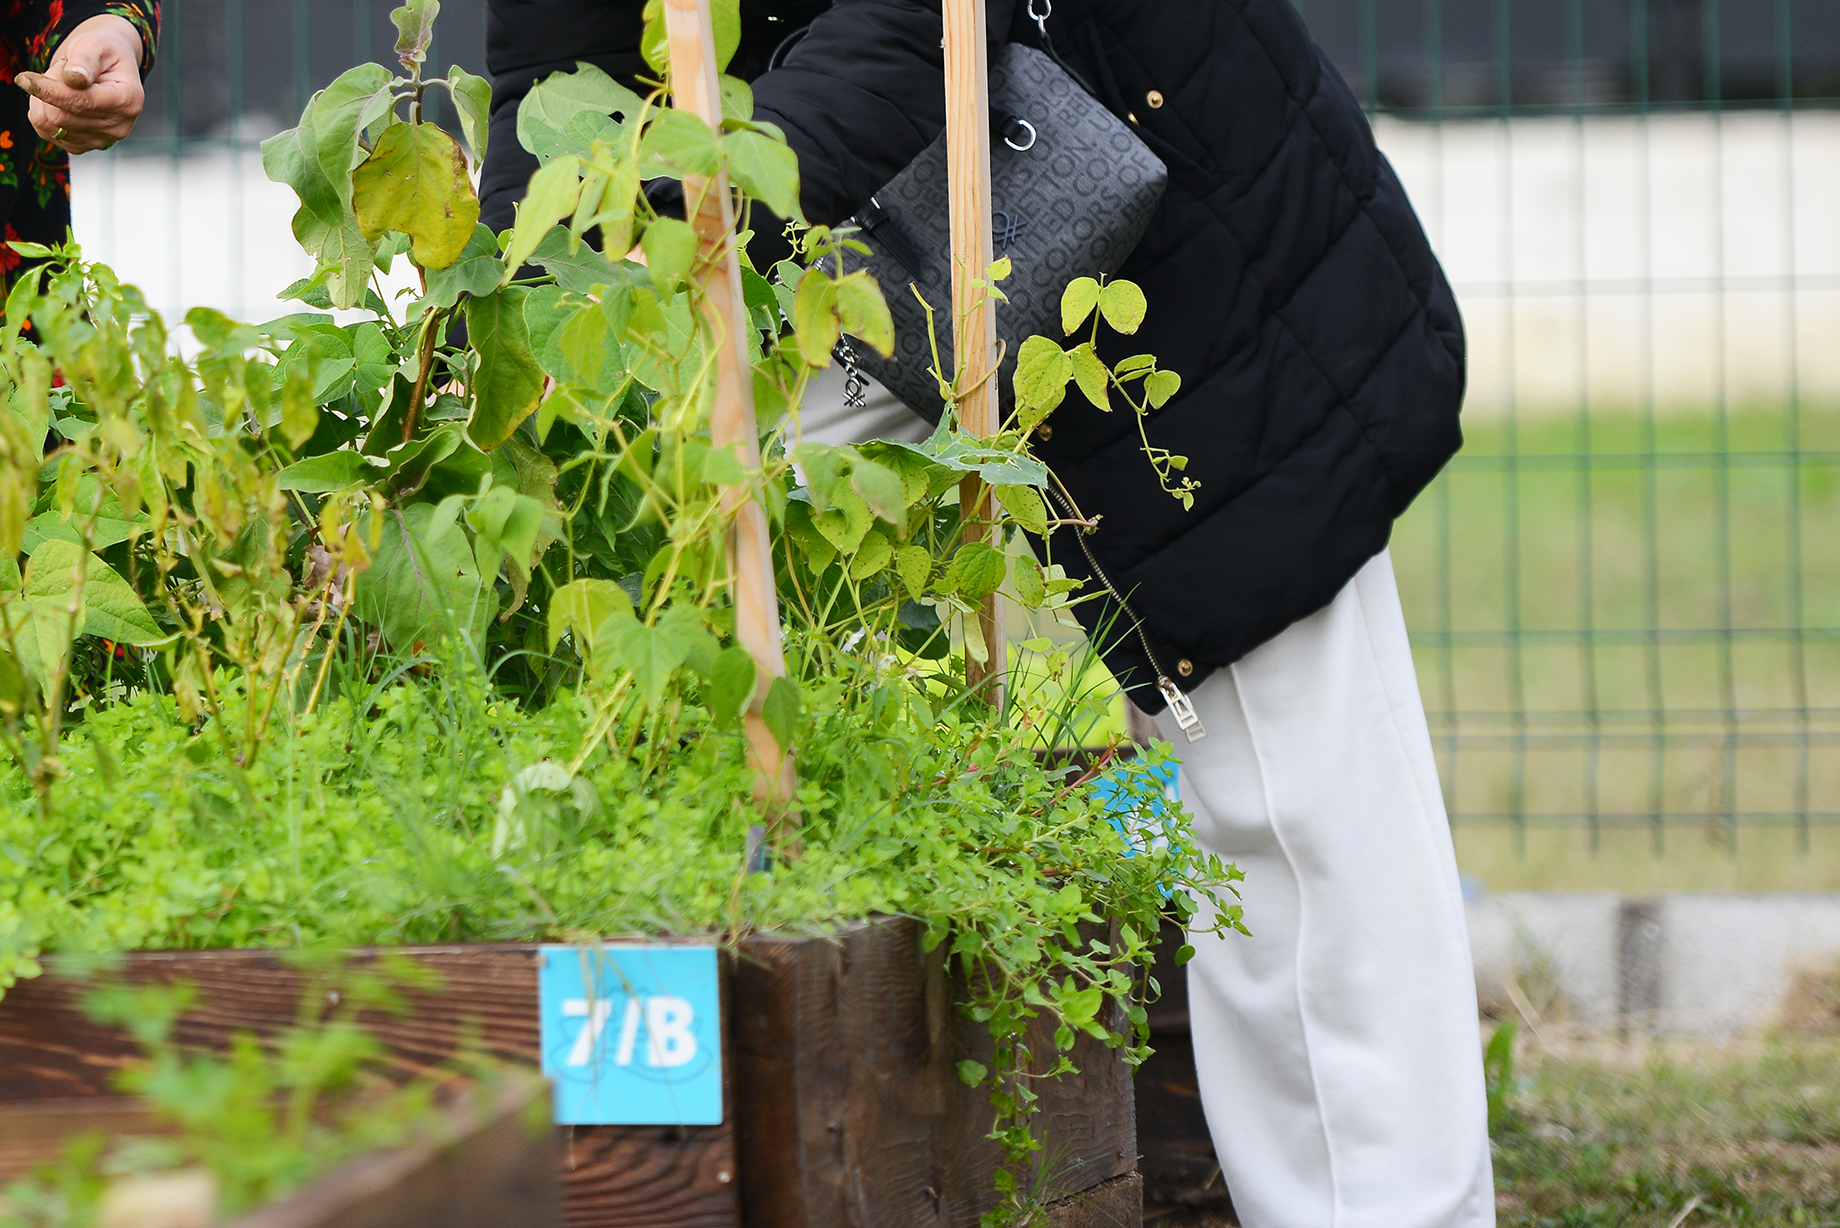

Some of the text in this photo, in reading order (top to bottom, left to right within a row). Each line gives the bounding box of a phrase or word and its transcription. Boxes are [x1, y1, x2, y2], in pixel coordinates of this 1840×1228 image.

[1026, 184, 1124, 290] COLORS
[1114, 151, 1153, 189] OF
[562, 996, 699, 1068] 7/B
